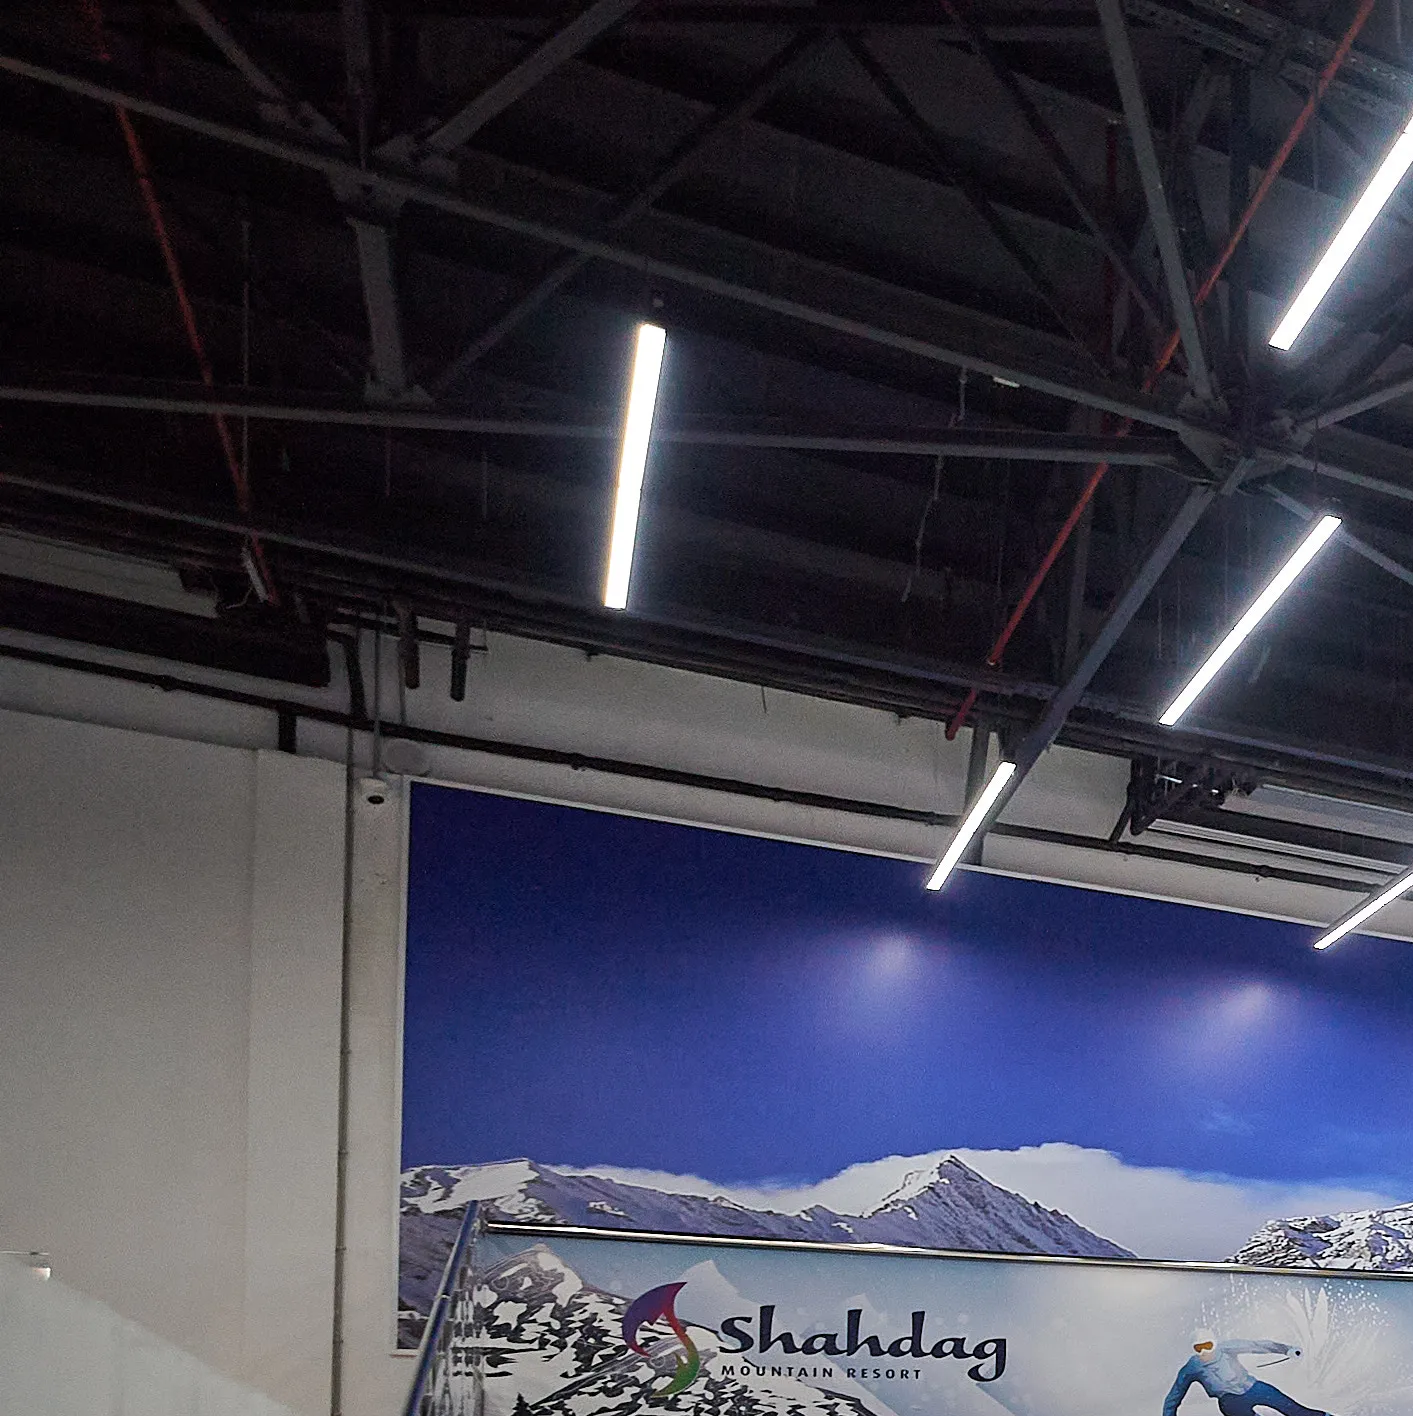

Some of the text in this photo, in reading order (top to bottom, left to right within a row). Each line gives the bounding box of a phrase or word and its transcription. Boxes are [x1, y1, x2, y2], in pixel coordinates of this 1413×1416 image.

[718, 1304, 1007, 1382] Shahdag
[721, 1364, 922, 1380] MOUNTAIN RESORT
